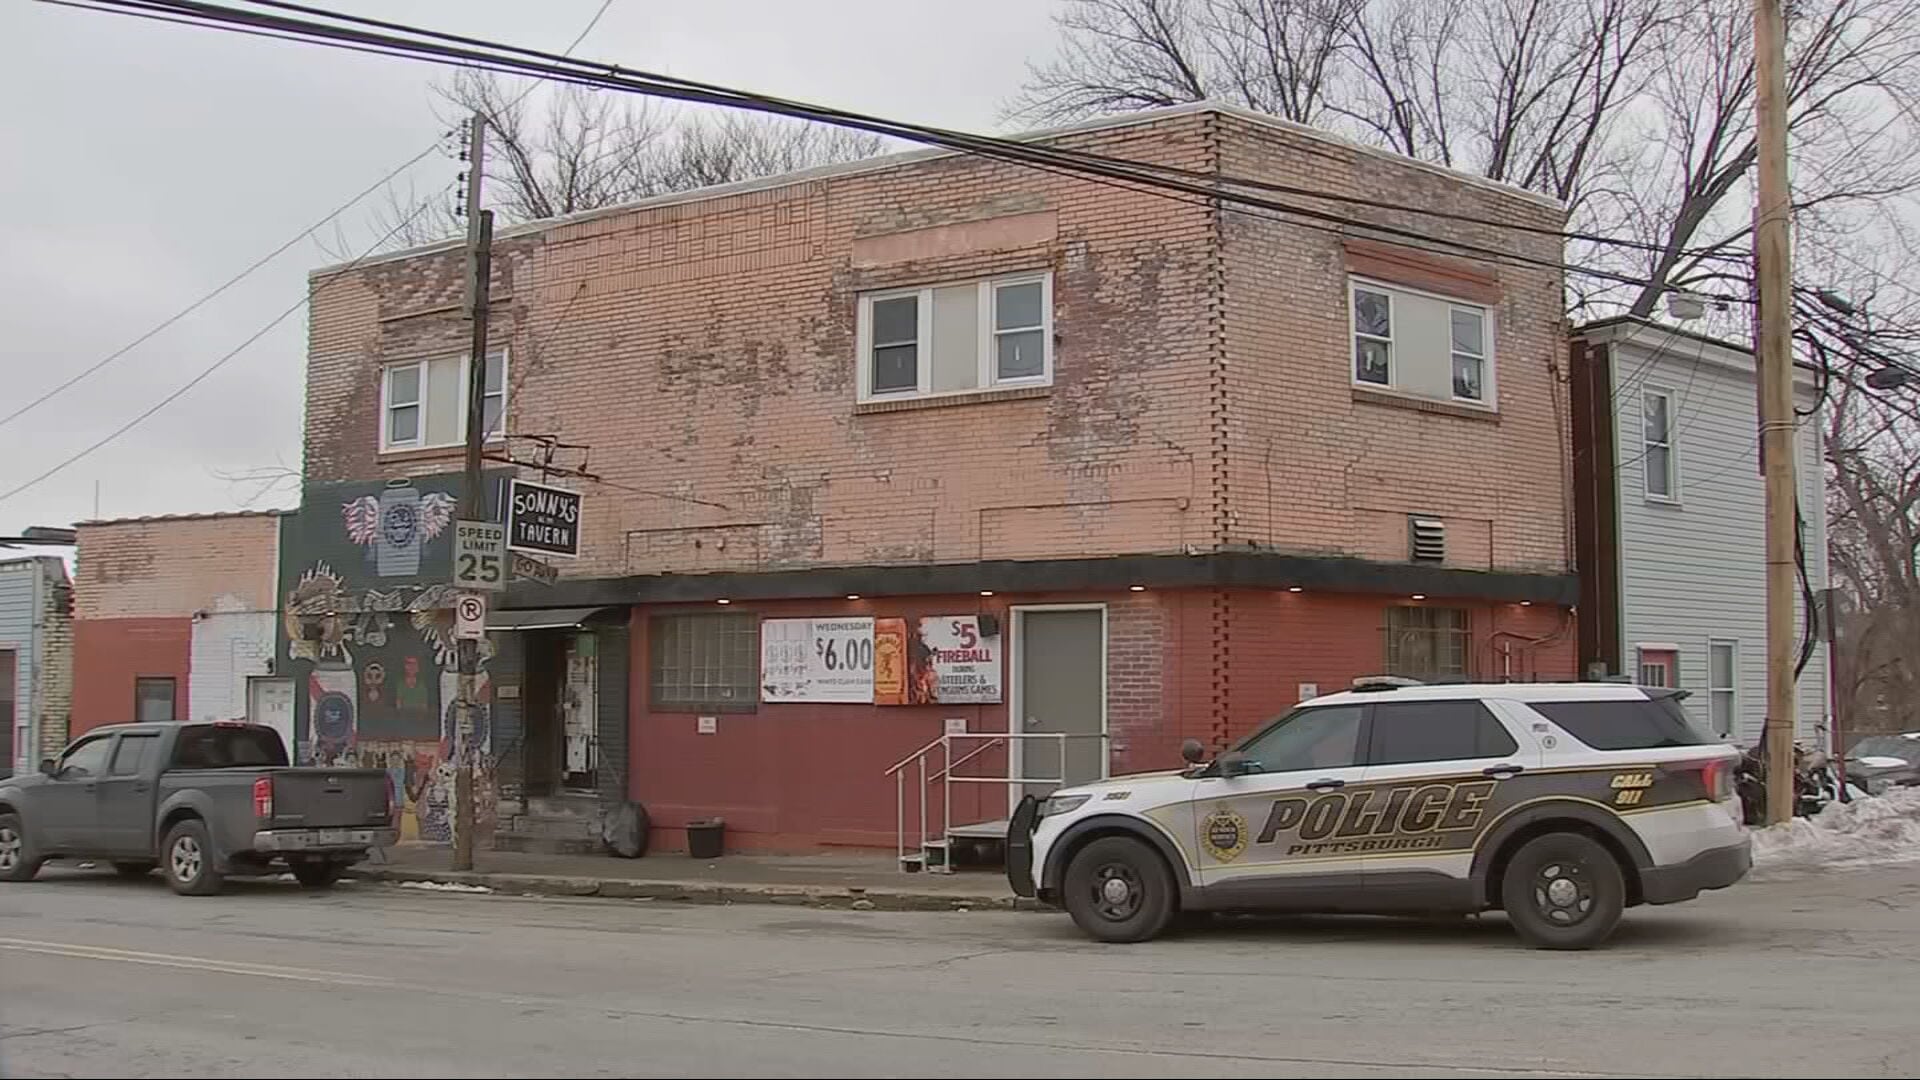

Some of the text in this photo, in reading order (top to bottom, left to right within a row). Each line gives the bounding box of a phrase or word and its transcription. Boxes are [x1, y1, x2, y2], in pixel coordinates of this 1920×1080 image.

[515, 490, 577, 523] SONNY'S
[458, 527, 502, 540] SPEED
[519, 522, 569, 546] TAVERN
[463, 540, 498, 552] LIMIT
[458, 553, 500, 582] 25
[815, 622, 873, 632] WEDNESDAY
[951, 620, 977, 649] $5
[815, 637, 872, 671] $6.00
[936, 648, 993, 663] FIREBALL
[940, 674, 987, 685] STEELERS &
[970, 685, 997, 695] GAMES
[1610, 773, 1653, 788] CALL
[1615, 790, 1644, 804] 911
[1255, 781, 1498, 845] POLICE
[1286, 836, 1442, 856] PITTSBURGH
